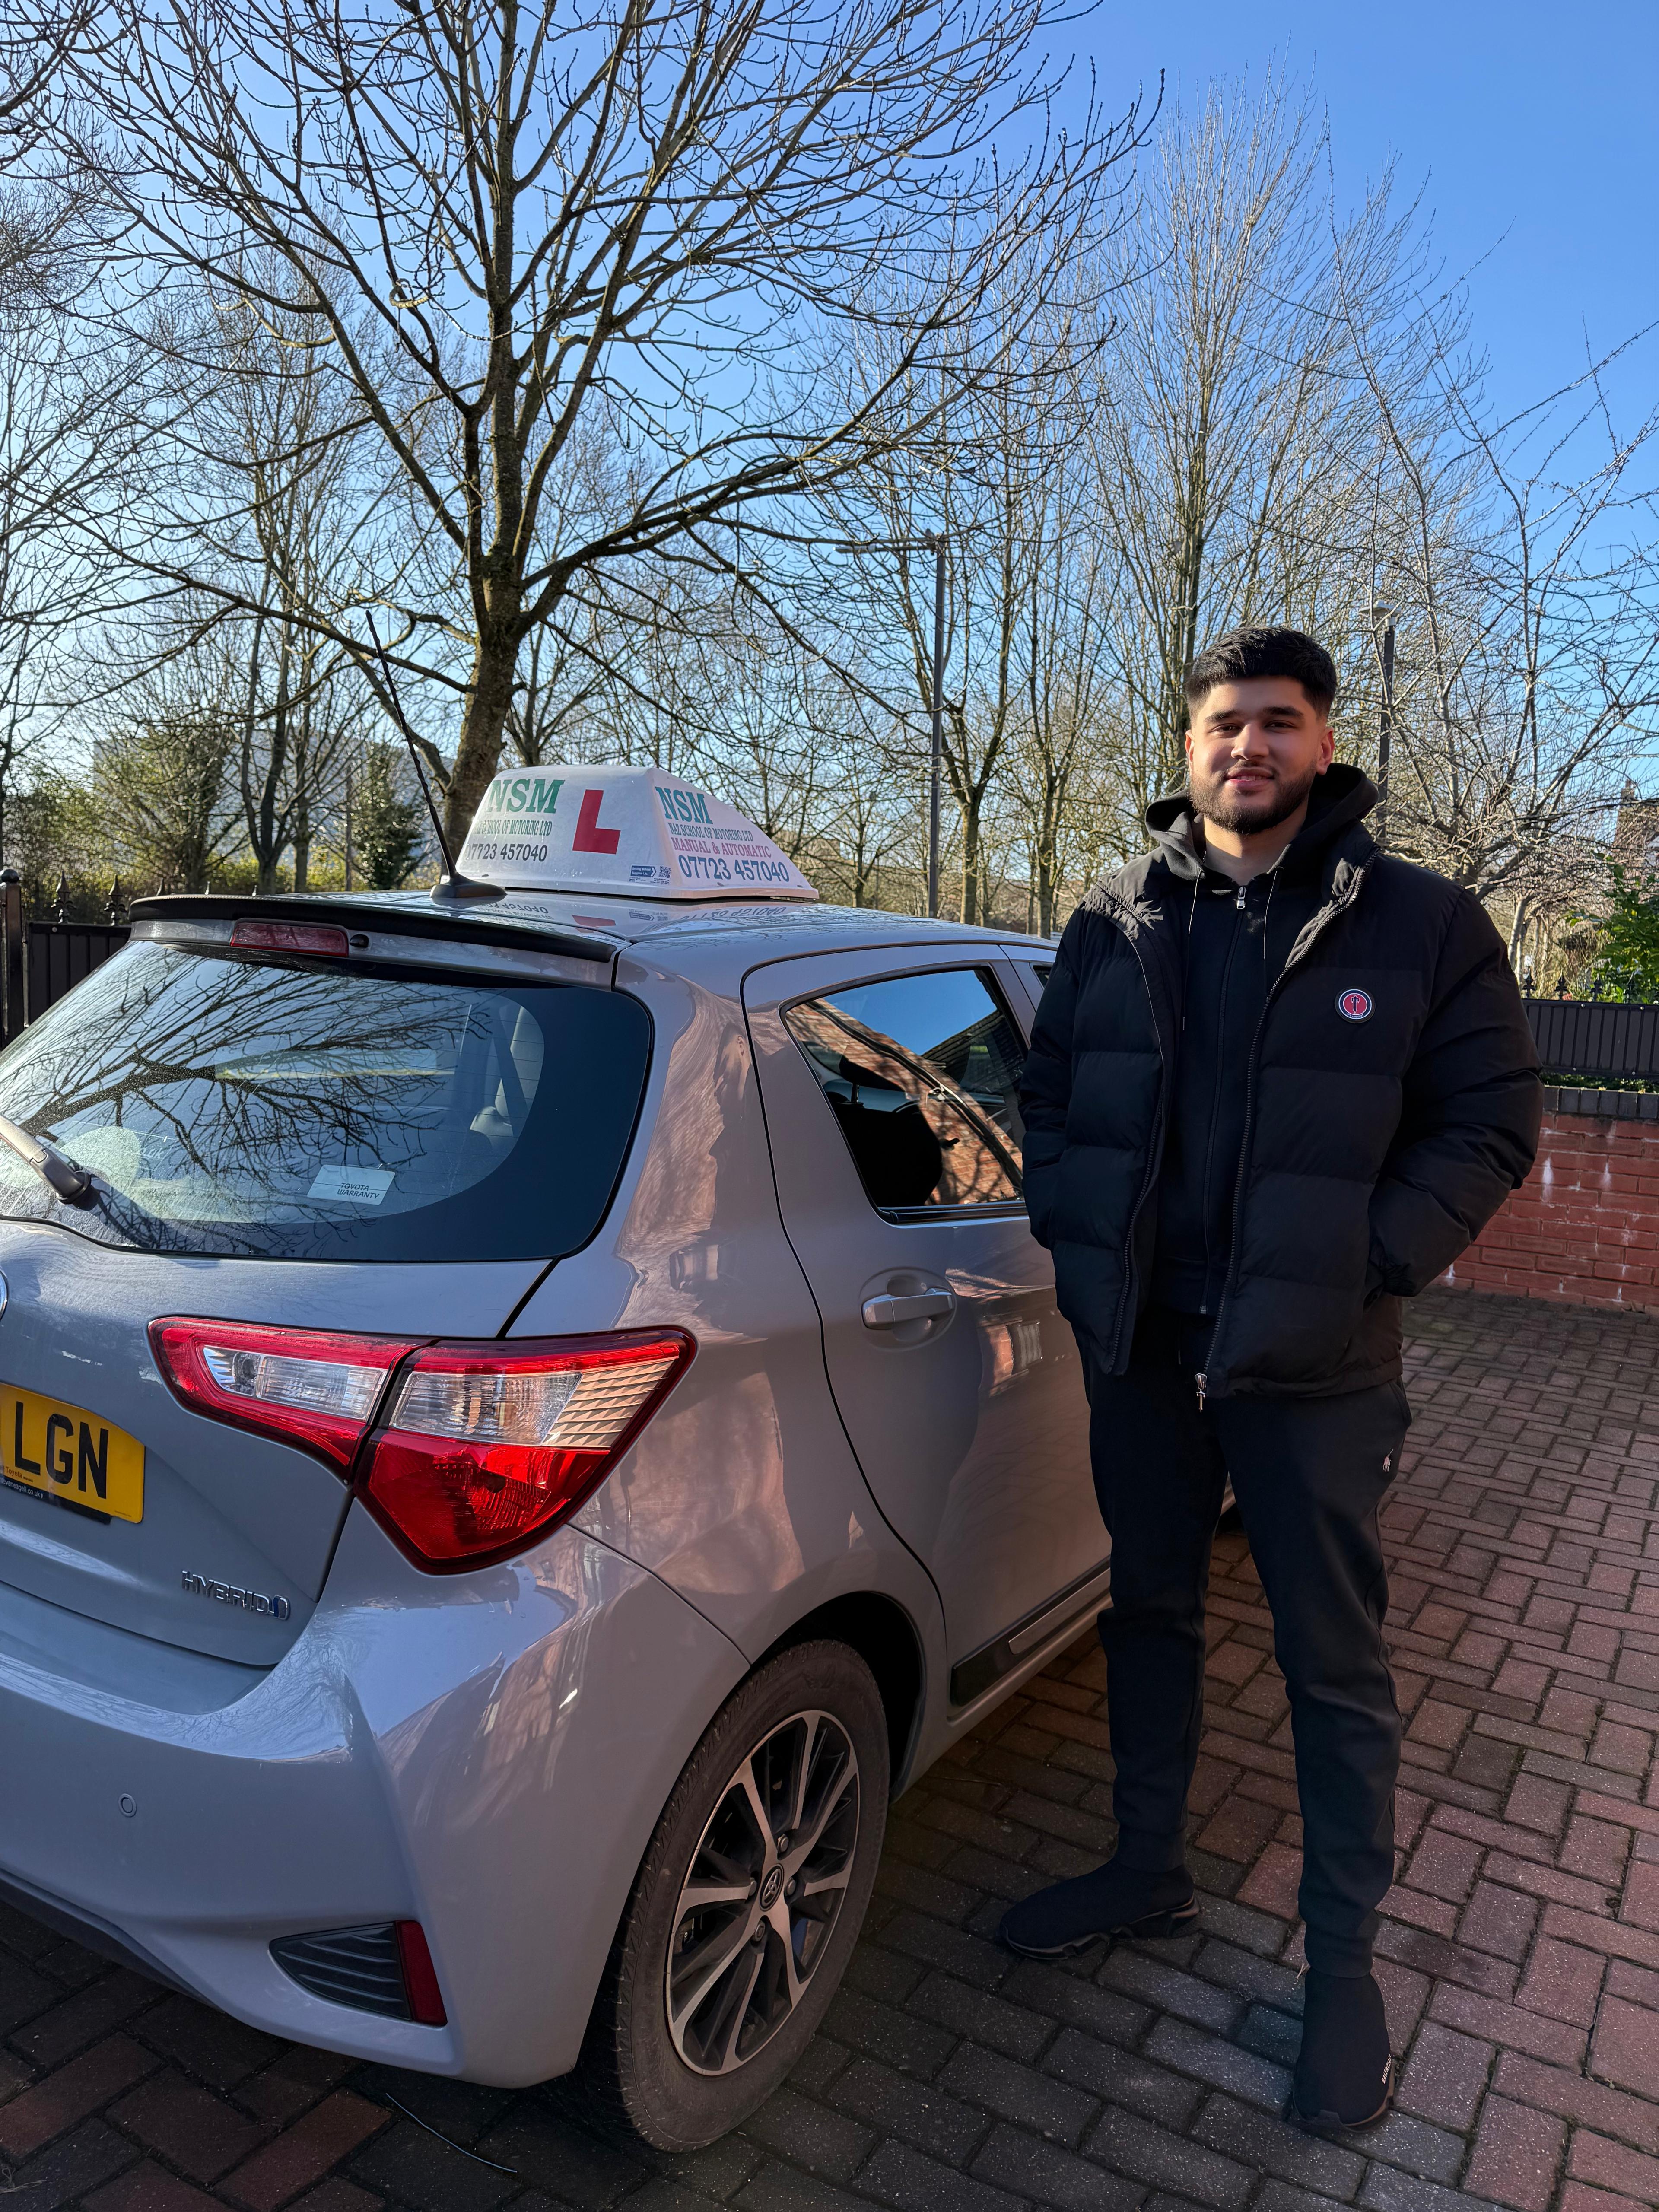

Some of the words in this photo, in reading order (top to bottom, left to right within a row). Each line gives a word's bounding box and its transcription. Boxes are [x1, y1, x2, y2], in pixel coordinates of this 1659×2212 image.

[485, 779, 565, 814] NSM
[655, 786, 713, 824] NSM
[502, 820, 510, 834] OF
[509, 820, 540, 836] MOTORING
[539, 820, 552, 836] LTD
[572, 789, 621, 855] L
[668, 823, 681, 835] NAZ
[680, 824, 705, 838] SCHOOL
[704, 827, 713, 839] OF
[712, 828, 742, 841] MOTORING
[742, 830, 753, 842] LTD
[465, 843, 497, 860] 07723
[500, 844, 547, 861] 457040
[671, 837, 711, 853] MANUAL
[712, 842, 720, 854] &
[721, 843, 771, 858] AUTOMATIC
[678, 855, 731, 880] 07723
[734, 859, 789, 882] 457040
[337, 1189, 380, 1199] WARRANTY
[341, 1182, 369, 1191] TOYOTA
[15, 1401, 109, 1499] LGN
[6, 1466, 22, 1478] Toyota
[181, 1570, 273, 1615] HYBRID
